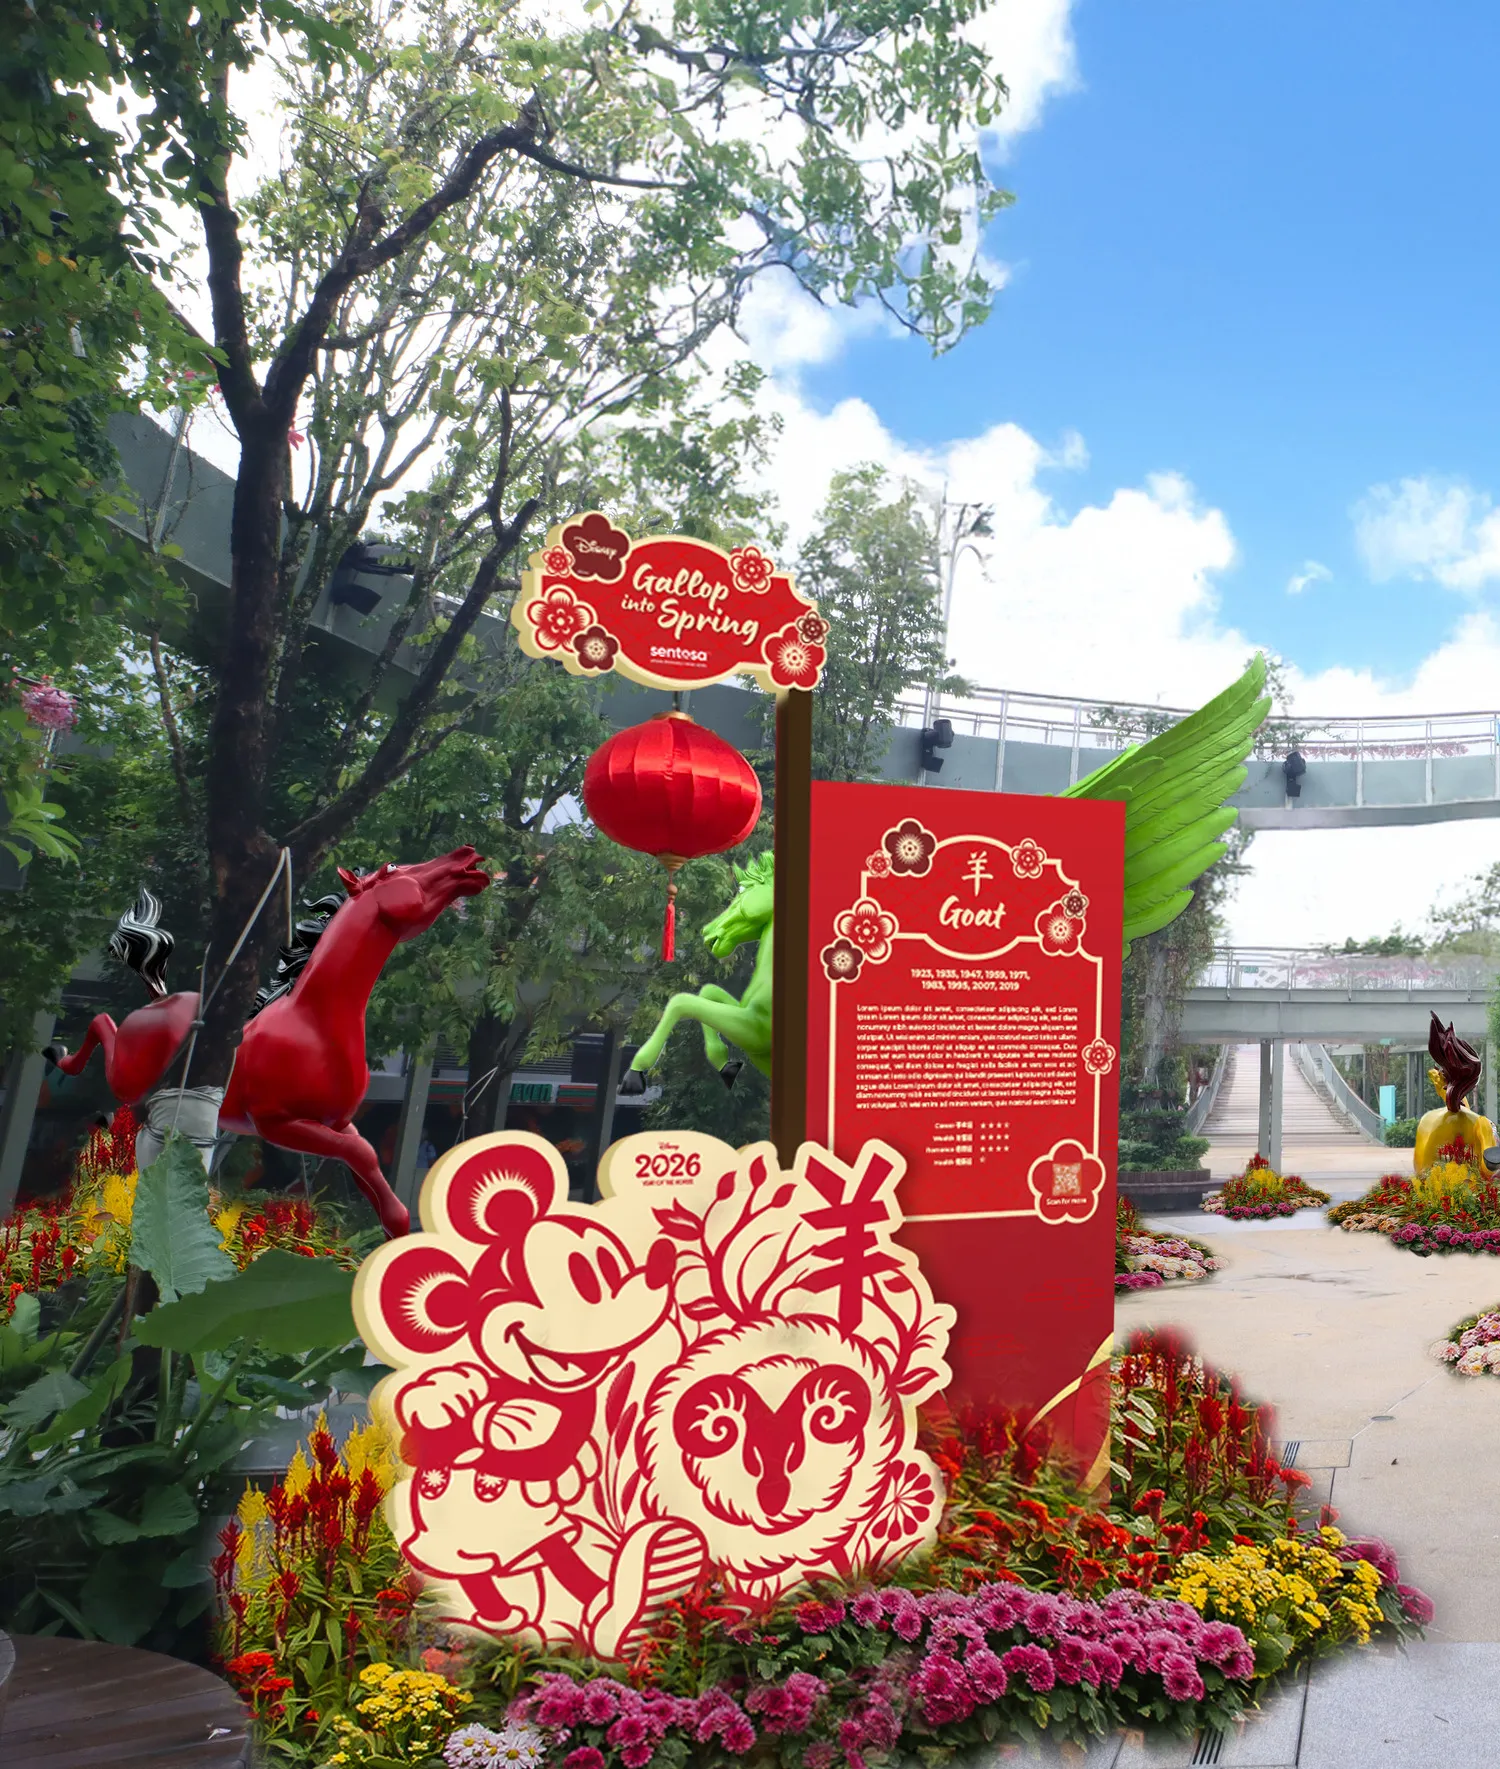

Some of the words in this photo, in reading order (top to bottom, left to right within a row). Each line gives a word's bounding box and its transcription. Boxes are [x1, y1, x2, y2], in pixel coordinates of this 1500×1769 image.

[573, 536, 618, 560] Disney
[632, 562, 730, 612] Gallop
[621, 593, 656, 613] into
[657, 597, 760, 647] Spring
[650, 645, 708, 662] sentosa
[961, 851, 994, 897] 羊
[939, 895, 1007, 930] Goat
[635, 1152, 702, 1179] 2026
[797, 1152, 906, 1338] 羊
